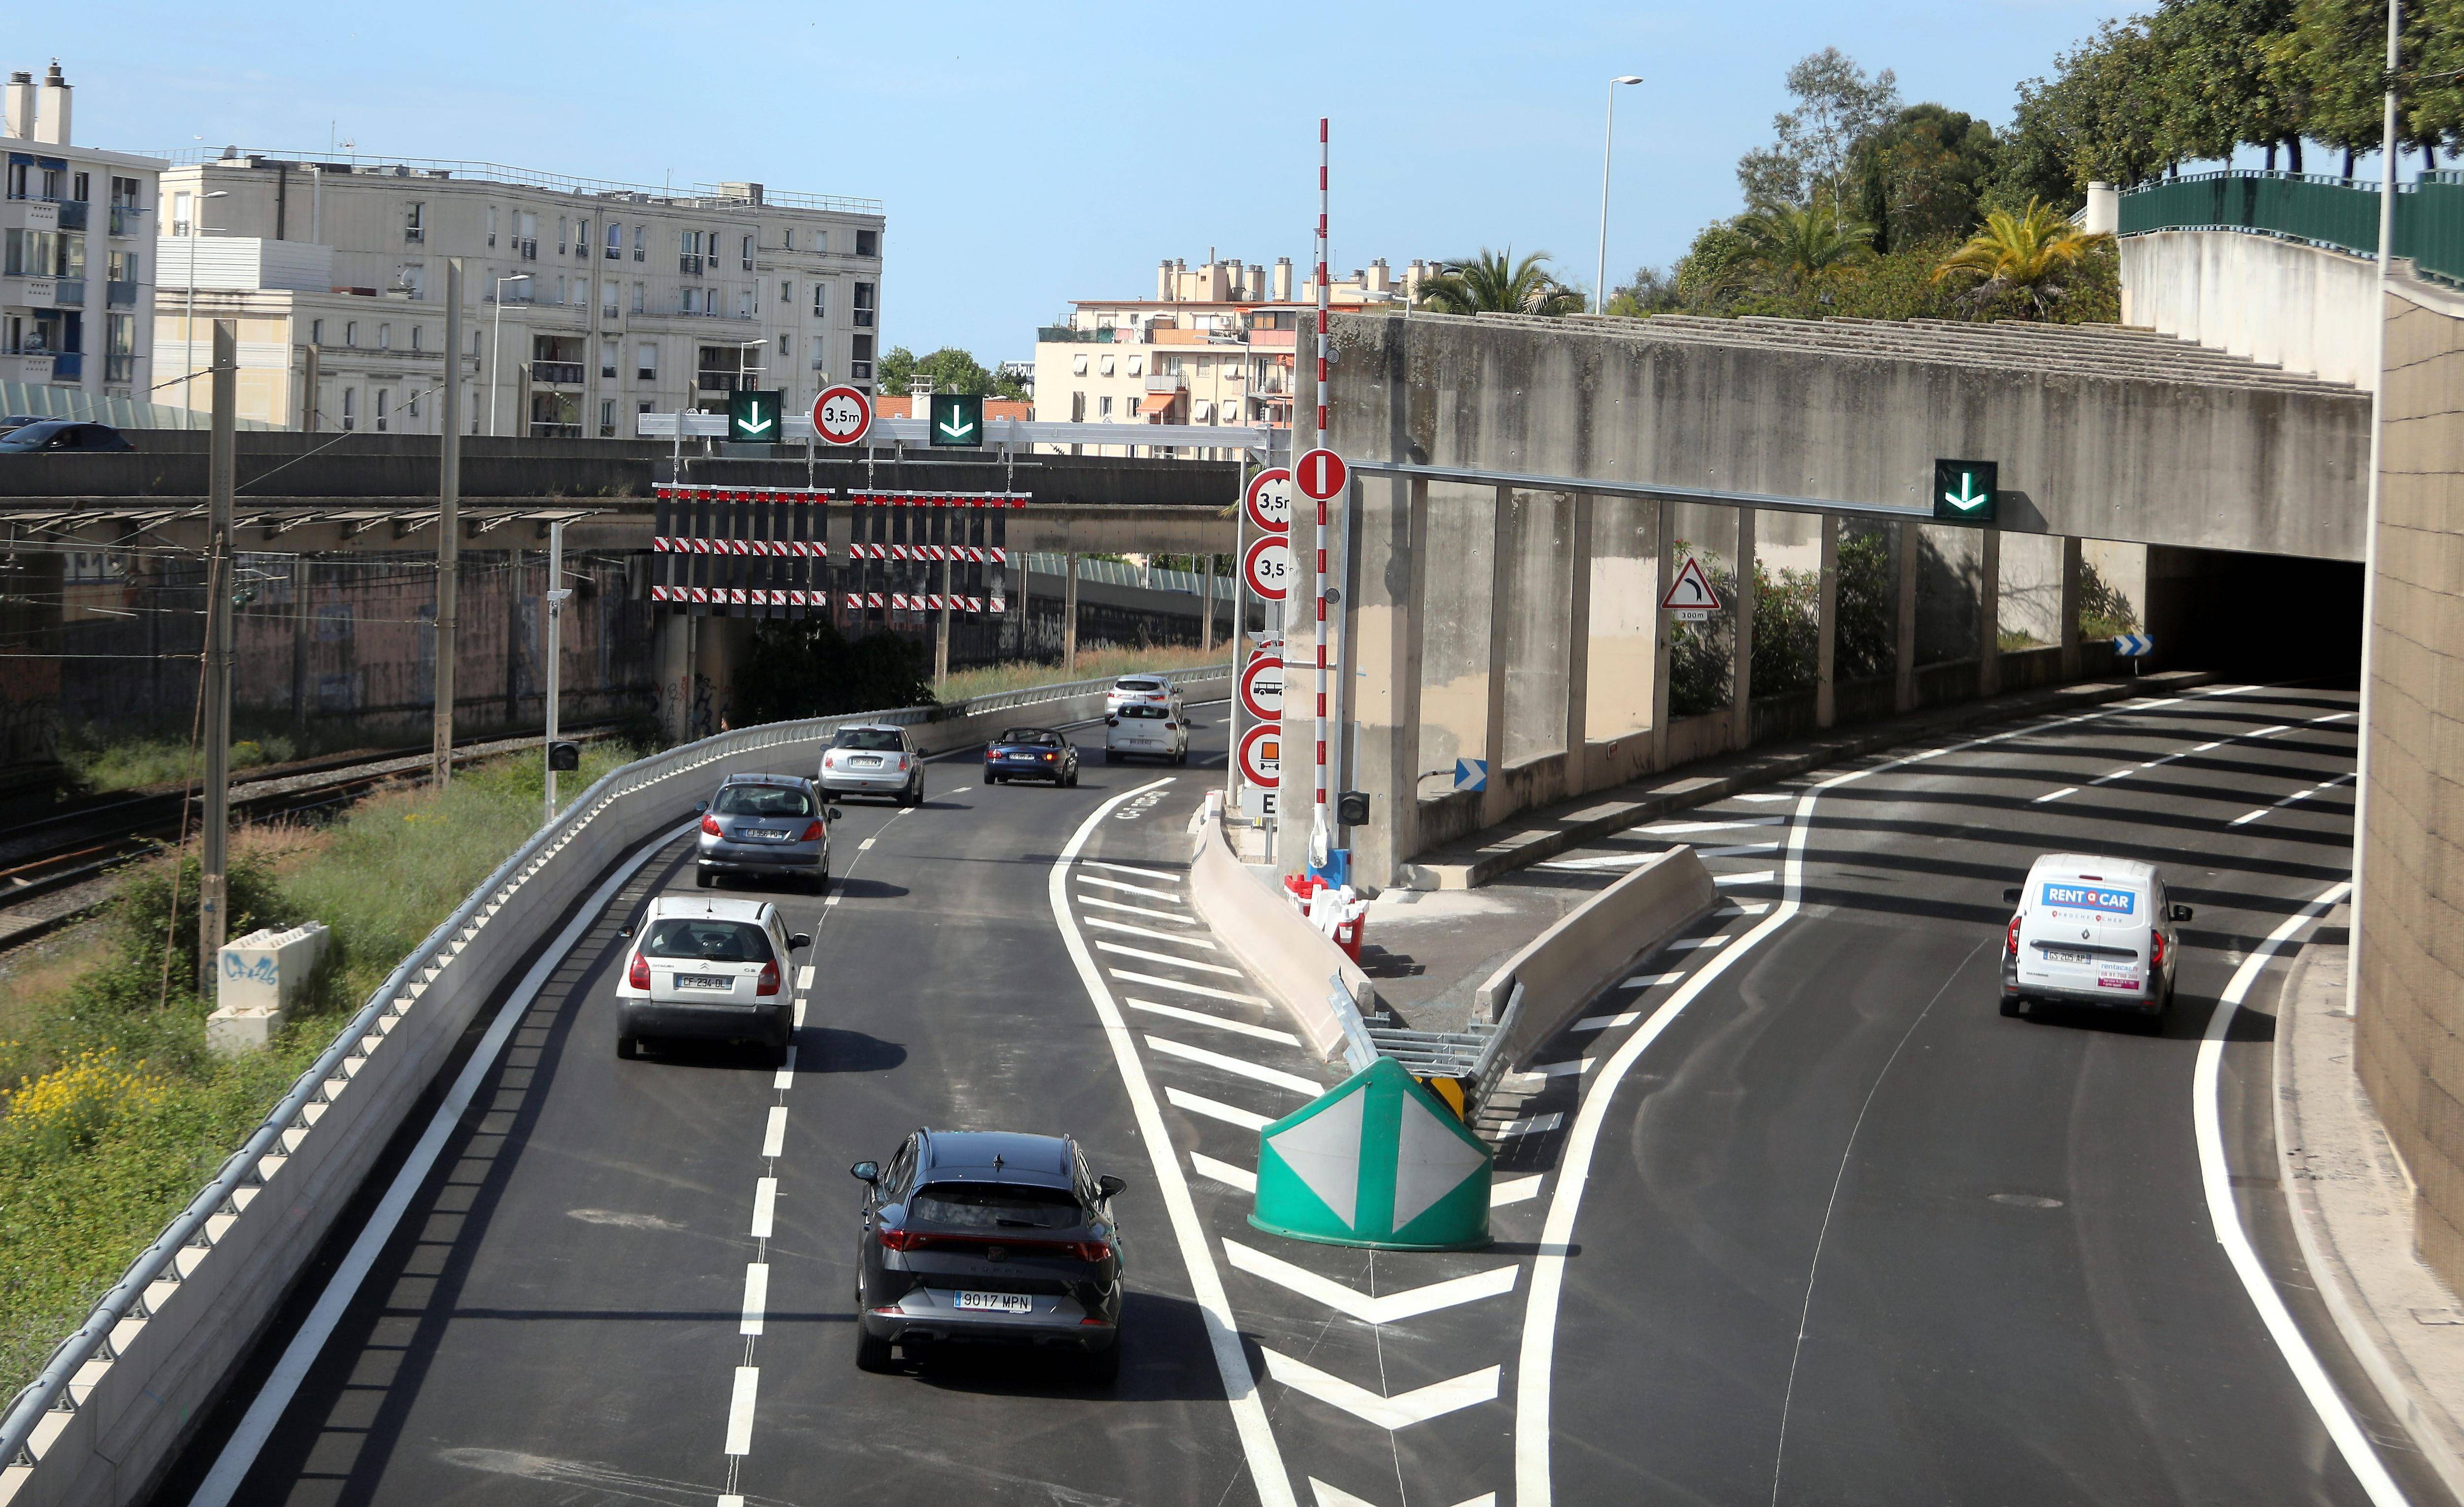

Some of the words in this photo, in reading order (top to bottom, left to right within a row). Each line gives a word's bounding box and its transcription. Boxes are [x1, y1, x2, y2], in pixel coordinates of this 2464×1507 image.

[824, 407, 859, 423] 3,5m
[1260, 559, 1288, 578] 3,5
[1263, 794, 1275, 813] E
[2049, 888, 2085, 903] RENT
[2088, 893, 2096, 902] a
[2099, 893, 2128, 908] CAR
[964, 1293, 998, 1307] 9017
[1002, 1295, 1028, 1309] MPN
